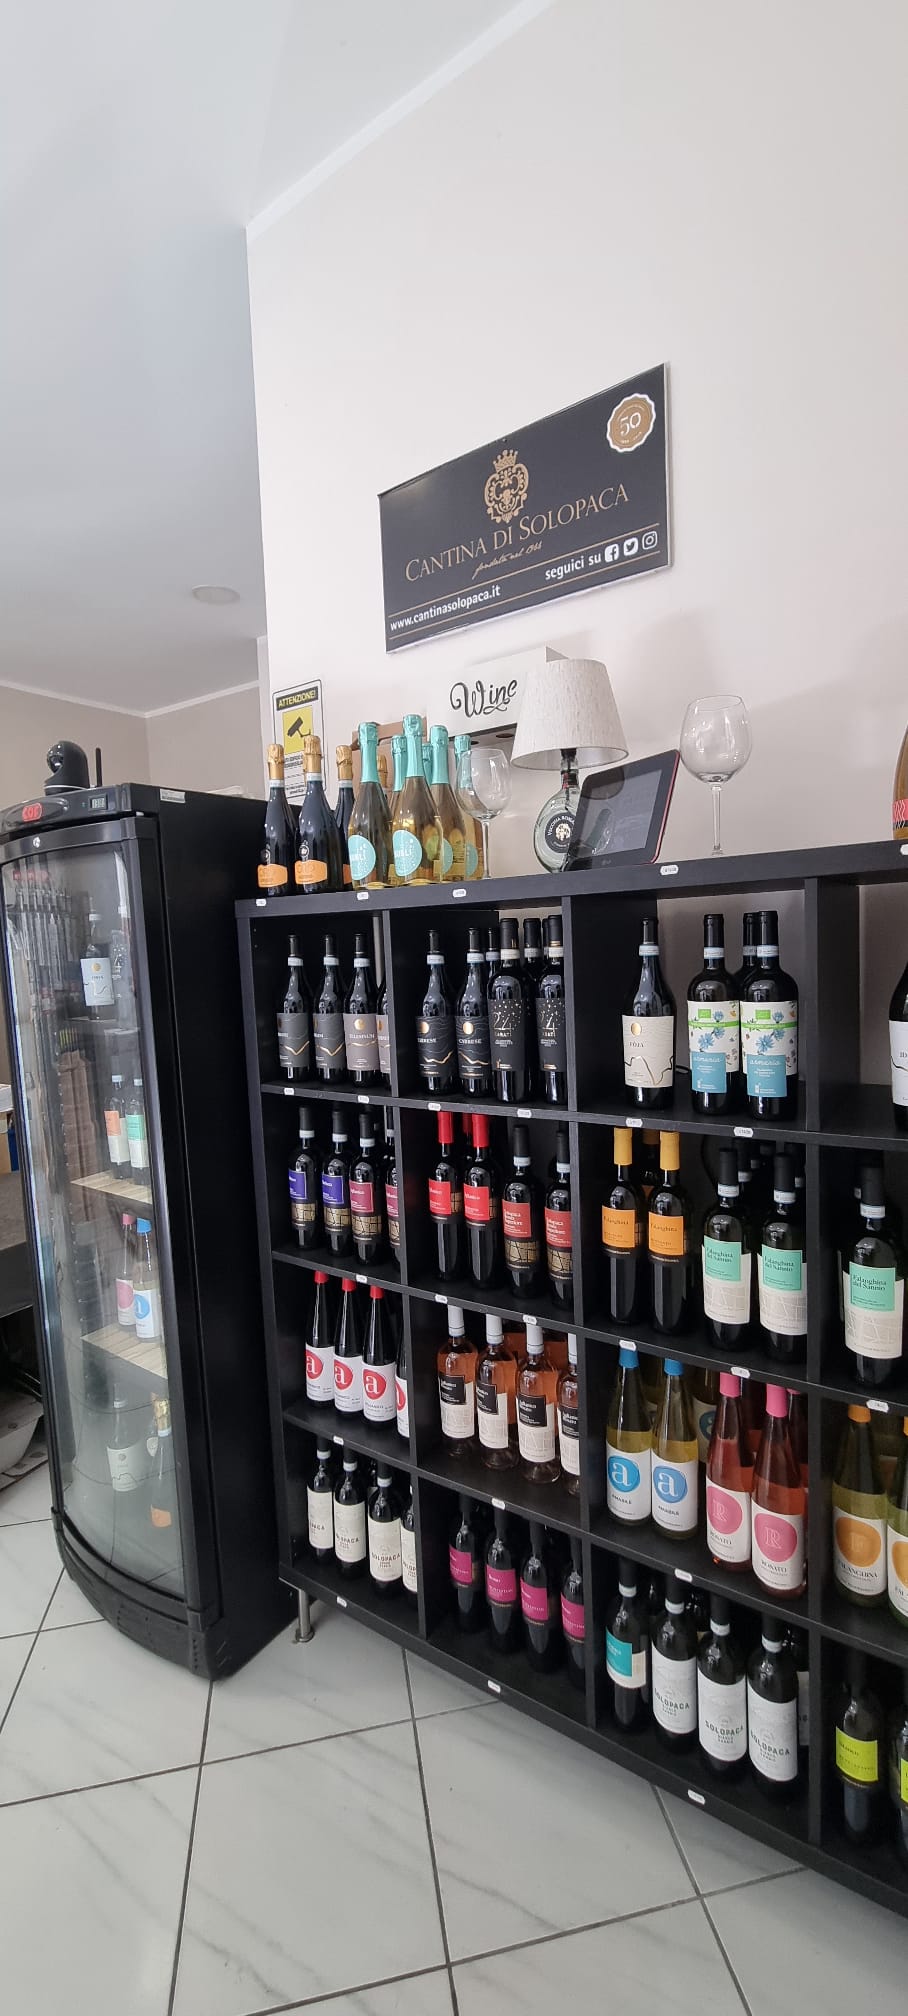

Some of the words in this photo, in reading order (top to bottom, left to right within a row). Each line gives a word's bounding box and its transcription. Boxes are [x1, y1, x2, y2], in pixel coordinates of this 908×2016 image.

[619, 412, 641, 437] 50
[493, 526, 514, 551] DI
[545, 559, 585, 581] seguici
[588, 553, 602, 566] su
[389, 585, 501, 633] www.cantinasolopaca.it
[450, 679, 518, 718] Wine
[853, 1274, 887, 1286] Falanghina
[863, 1283, 886, 1291] Sannio
[365, 1375, 379, 1393] a
[611, 1462, 629, 1487] a
[657, 1473, 678, 1497] a
[704, 1719, 744, 1736] SOLOPACA
